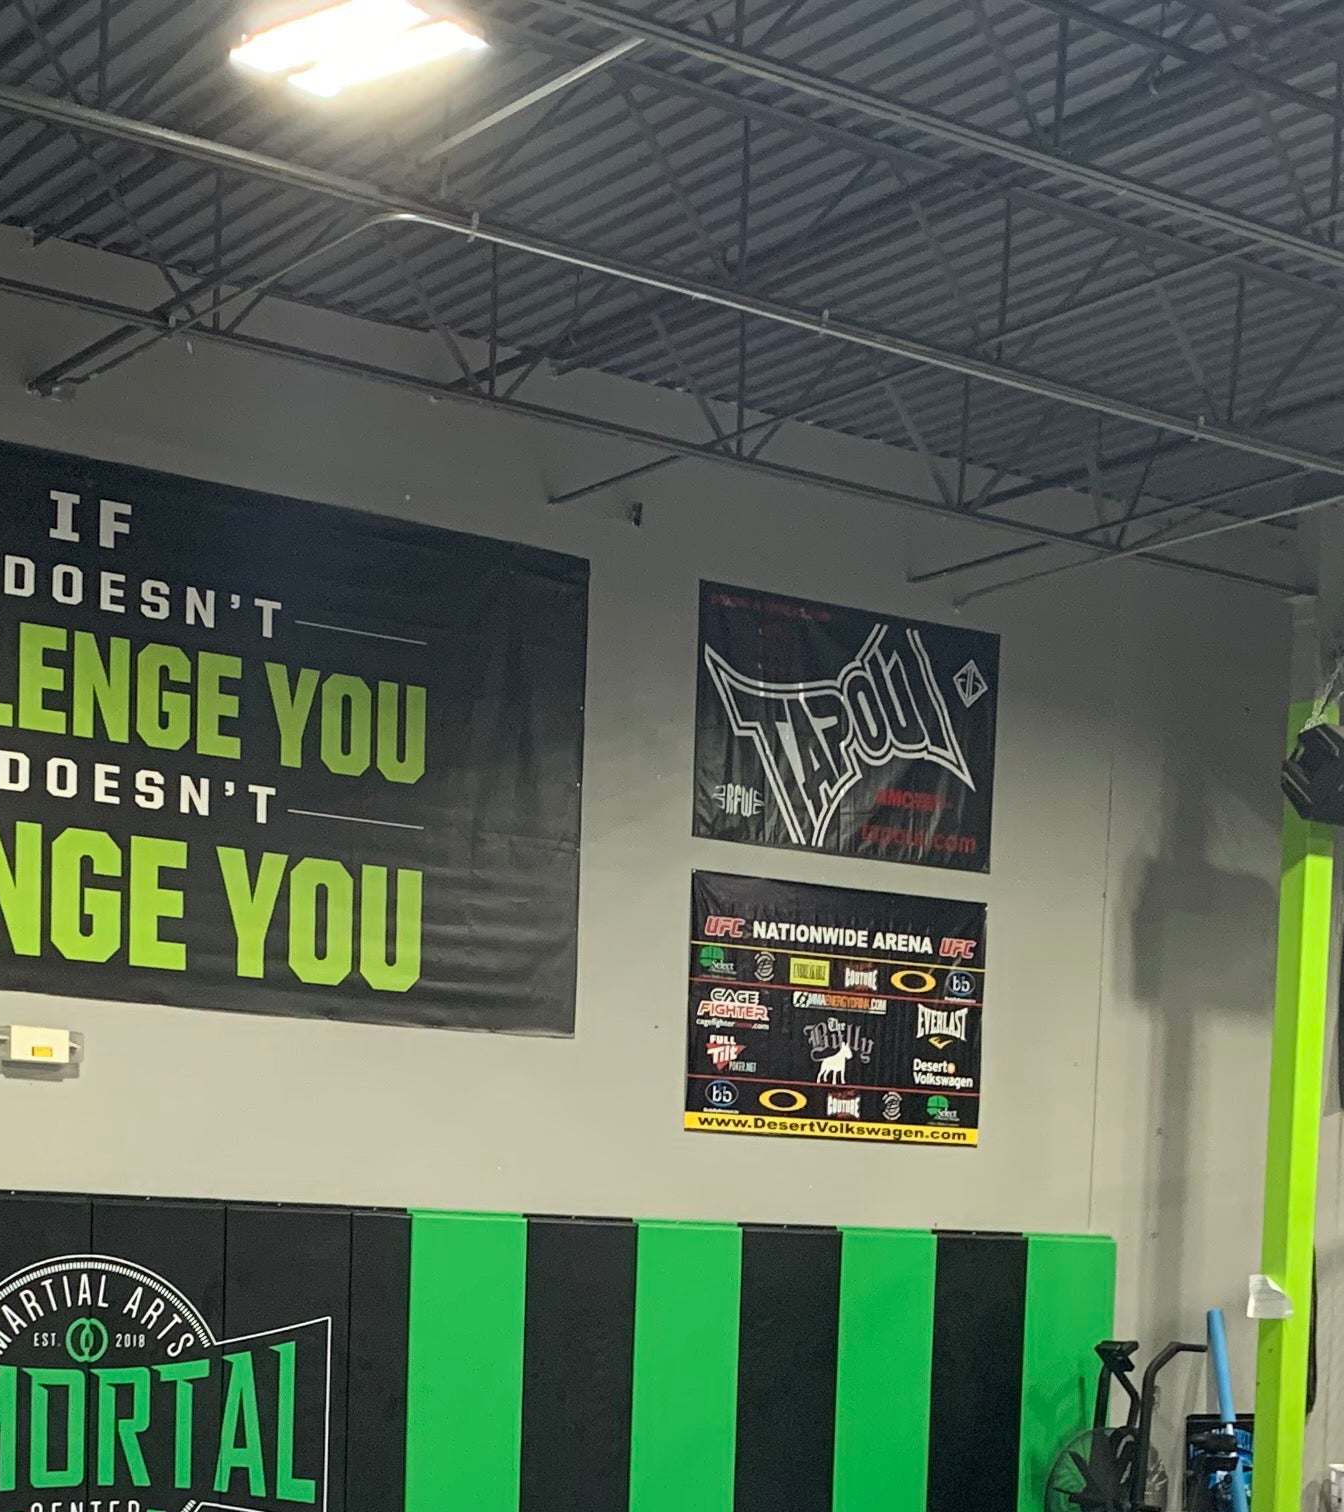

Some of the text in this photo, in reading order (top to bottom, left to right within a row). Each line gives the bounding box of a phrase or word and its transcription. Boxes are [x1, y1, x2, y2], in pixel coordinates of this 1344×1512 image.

[47, 489, 133, 550] IF
[3, 554, 284, 640] DOESN'T
[263, 661, 428, 785] YOU
[215, 846, 424, 994] YOU
[704, 915, 746, 938] UFC
[752, 920, 934, 955] NATIONWIDE ARENA
[939, 937, 977, 959] UFC
[710, 988, 760, 1005] CAGE
[697, 1000, 770, 1022] FIGHTER
[827, 1017, 846, 1032] The
[916, 1003, 969, 1042] EVERLAST
[709, 1034, 737, 1045] FULL
[913, 1058, 948, 1072] Desert
[913, 1071, 974, 1090] Volkswagen
[698, 1116, 967, 1141] www.DesertVolkswagen.com
[122, 1285, 195, 1358] ARTS
[33, 1332, 62, 1348] EST.
[115, 1333, 147, 1349] 2018
